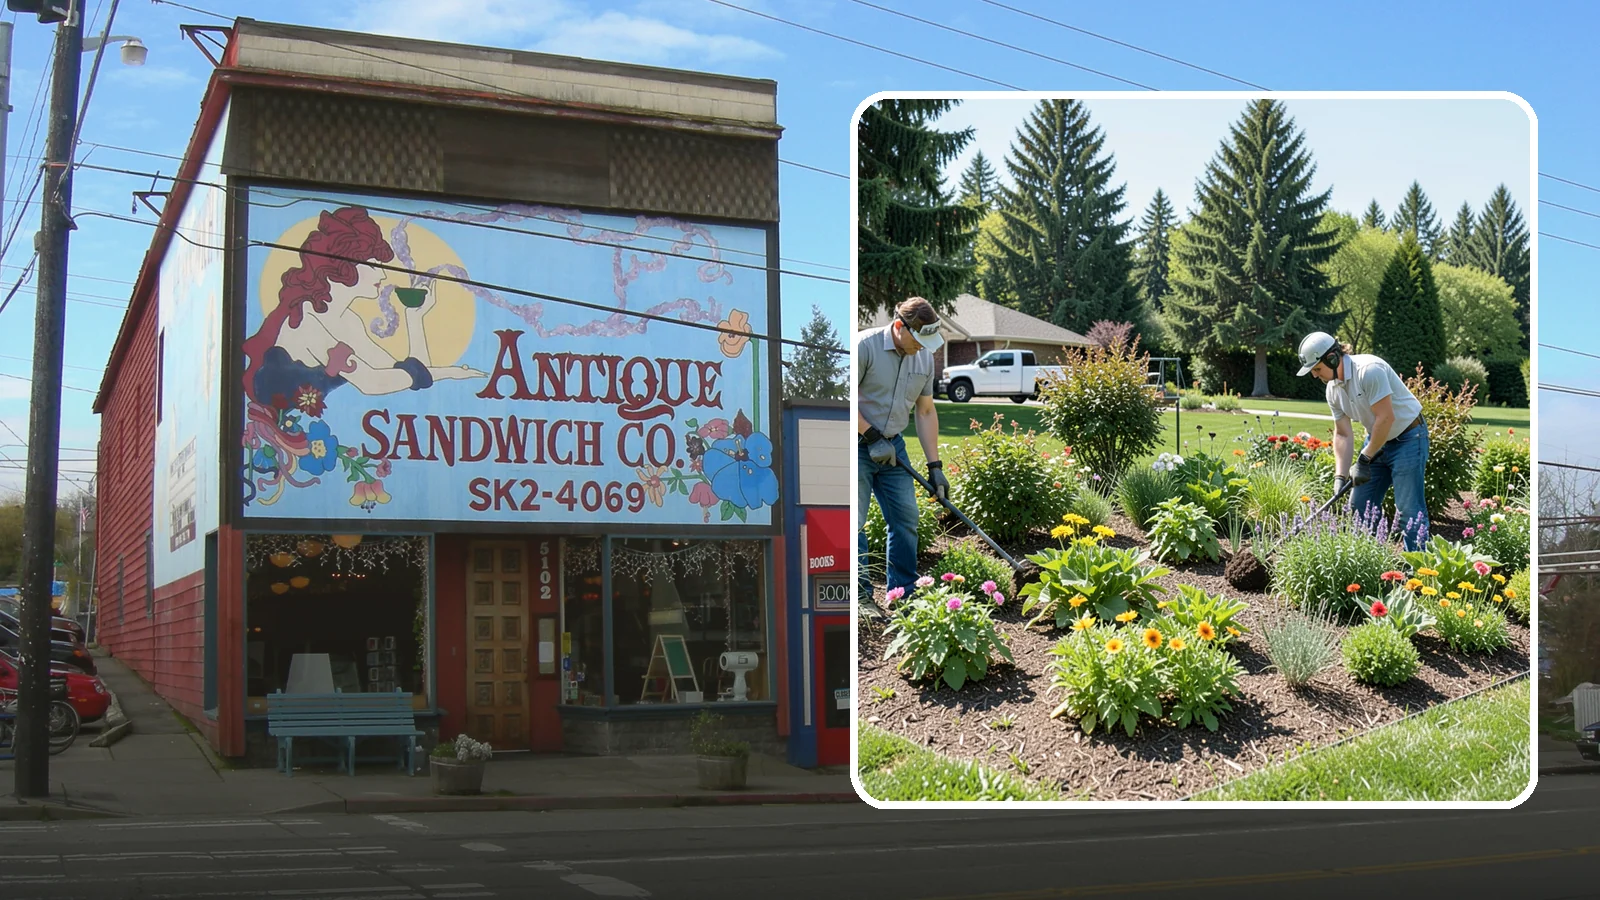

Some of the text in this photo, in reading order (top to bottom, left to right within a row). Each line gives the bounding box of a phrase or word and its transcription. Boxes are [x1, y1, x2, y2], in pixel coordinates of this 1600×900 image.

[476, 328, 724, 421] ANTIQUE
[361, 408, 685, 468] SANDWICH CO.
[468, 477, 645, 513] SK2-4069
[540, 541, 551, 599] 5102
[809, 555, 835, 569] BOOKS
